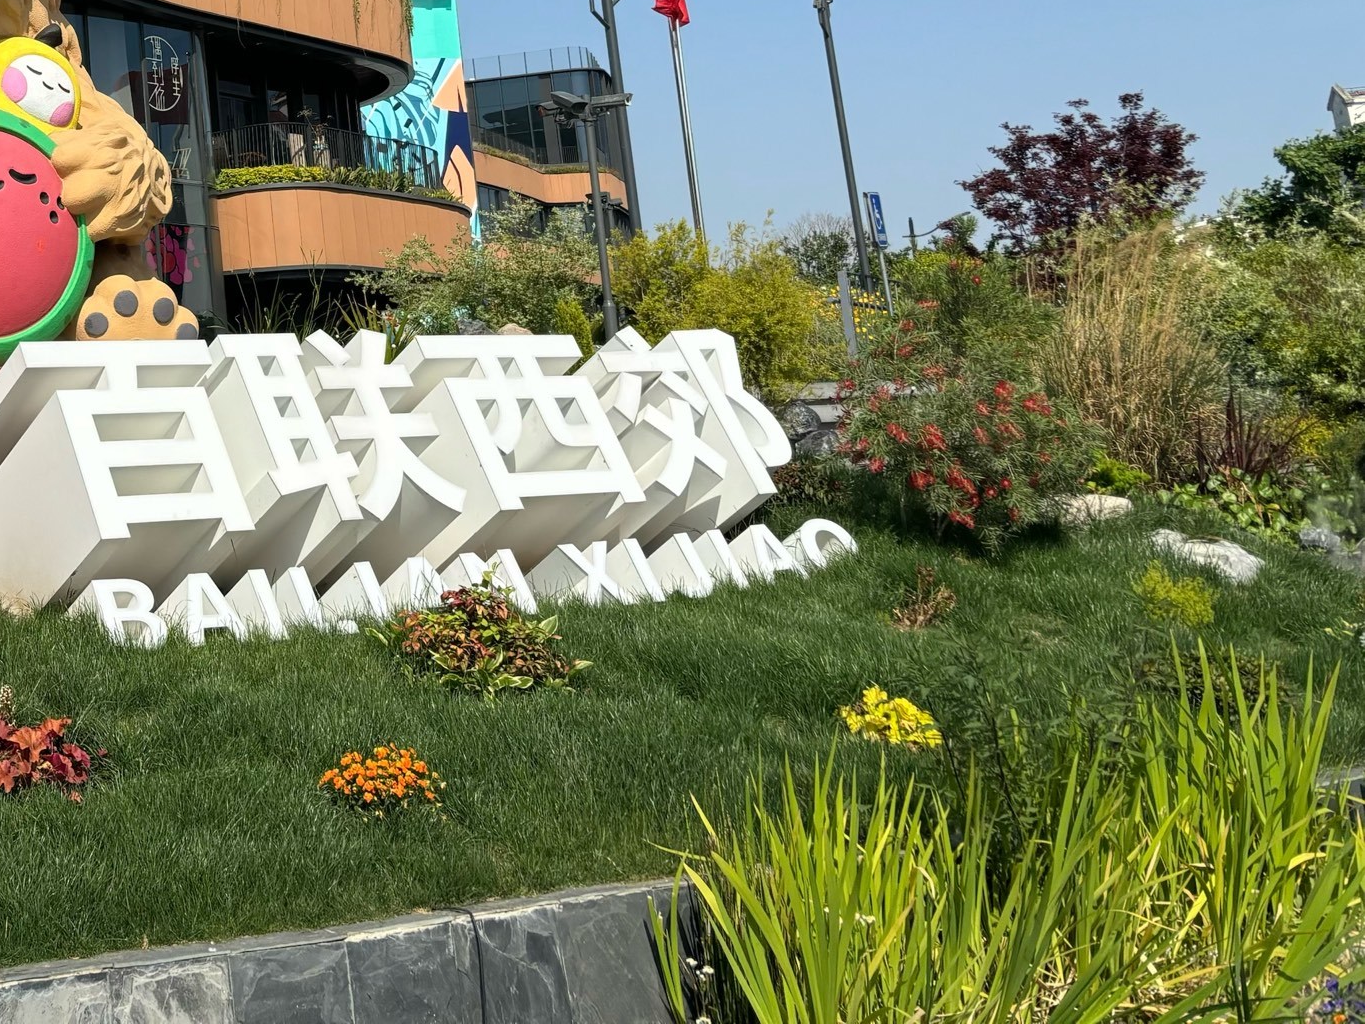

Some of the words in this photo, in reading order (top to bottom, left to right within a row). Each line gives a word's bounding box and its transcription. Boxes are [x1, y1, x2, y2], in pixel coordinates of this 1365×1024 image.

[18, 326, 792, 540] 百联西郊
[557, 517, 859, 607] XIJIAO
